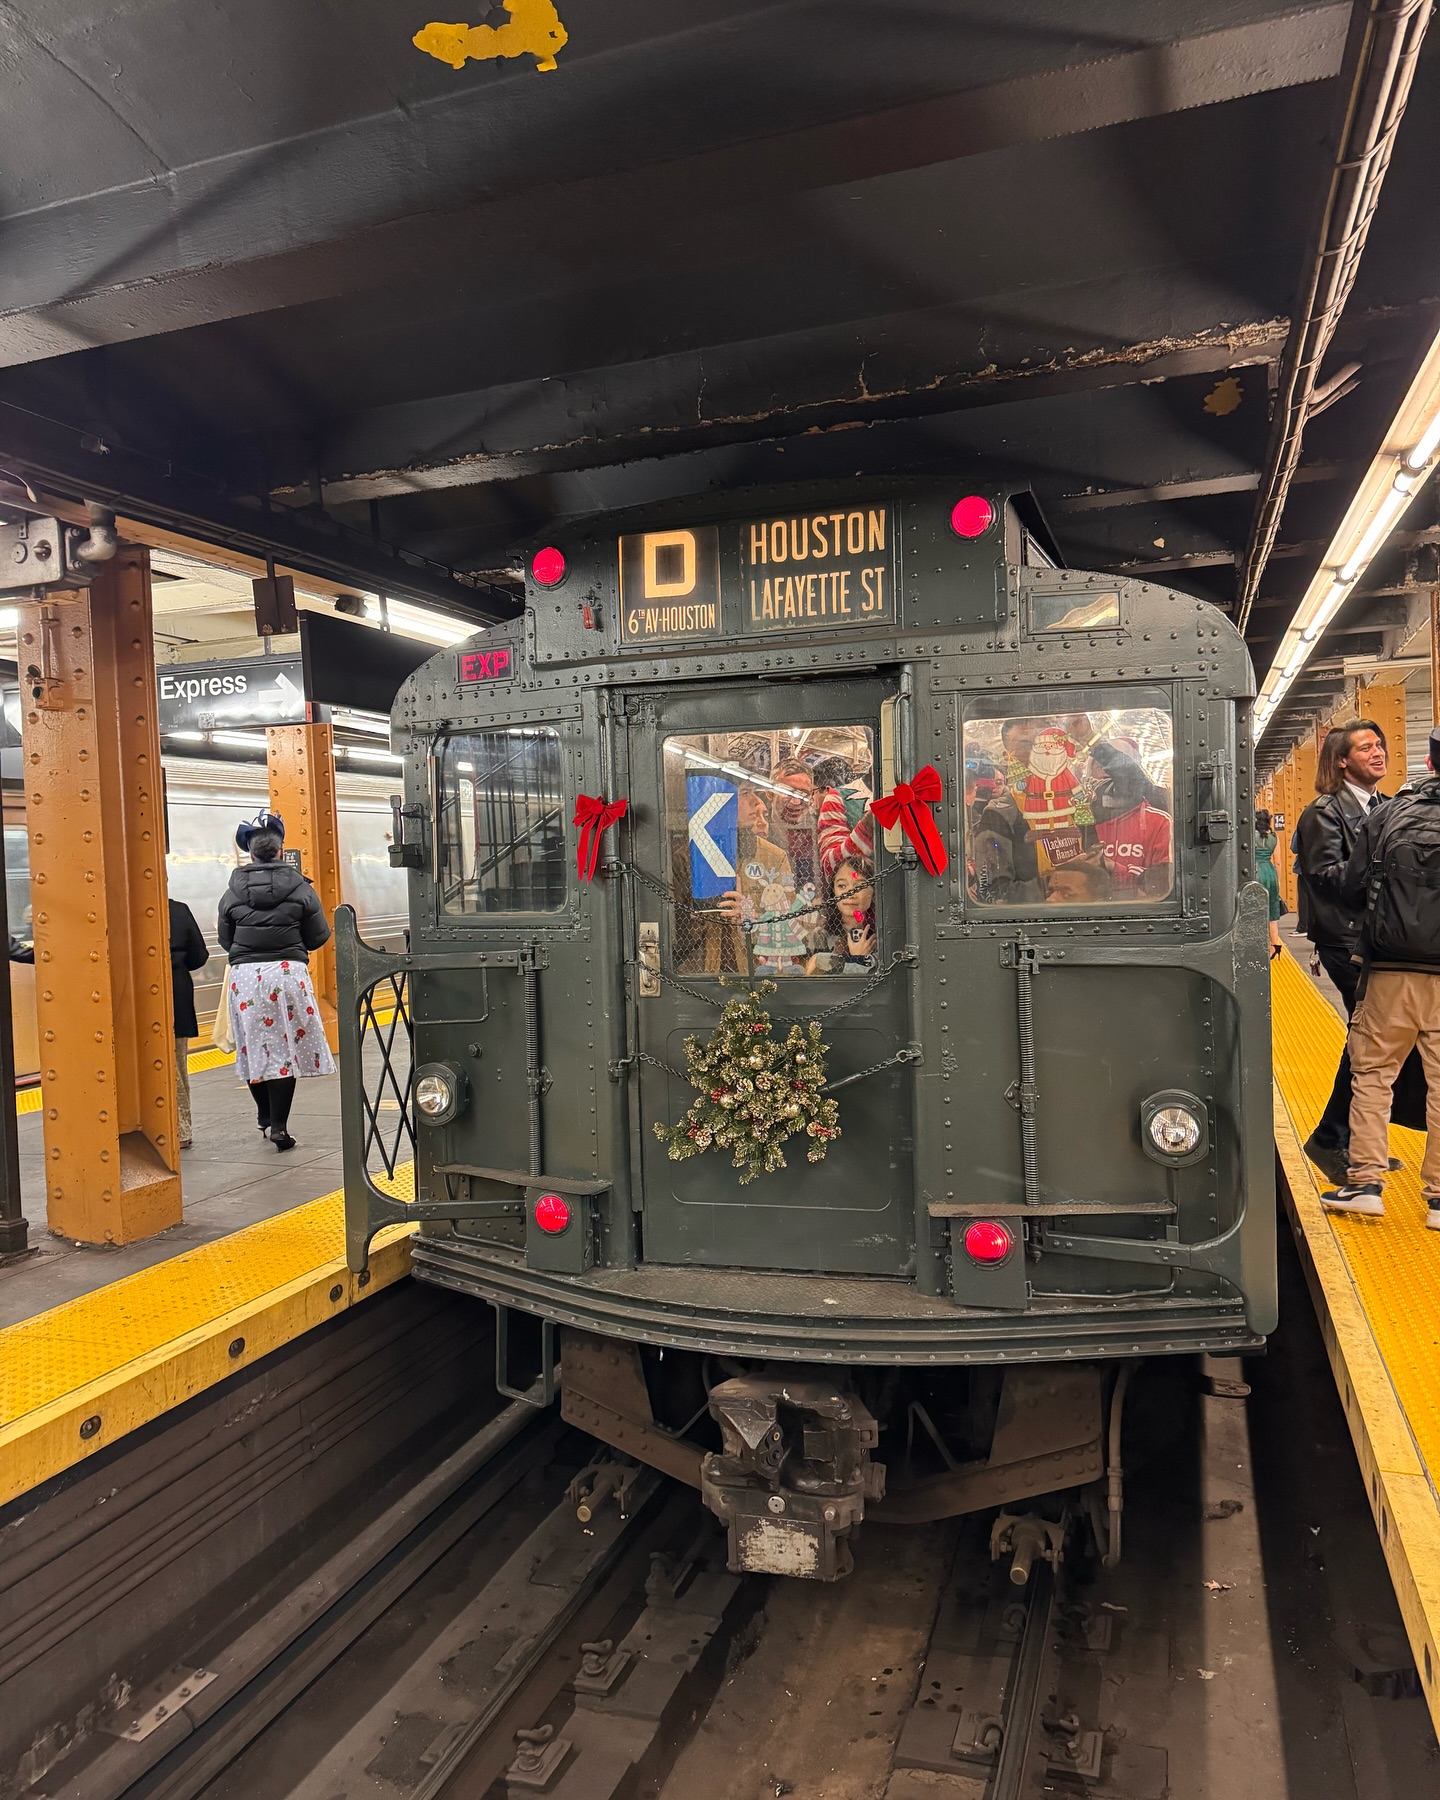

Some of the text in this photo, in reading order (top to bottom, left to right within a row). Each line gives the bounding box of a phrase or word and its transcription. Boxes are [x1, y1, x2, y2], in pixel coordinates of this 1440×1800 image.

[751, 510, 886, 565] HOUSTON
[644, 531, 696, 599] D
[751, 567, 885, 621] LAFAYETTE ST
[160, 675, 248, 703] Express
[461, 651, 509, 680] EXP
